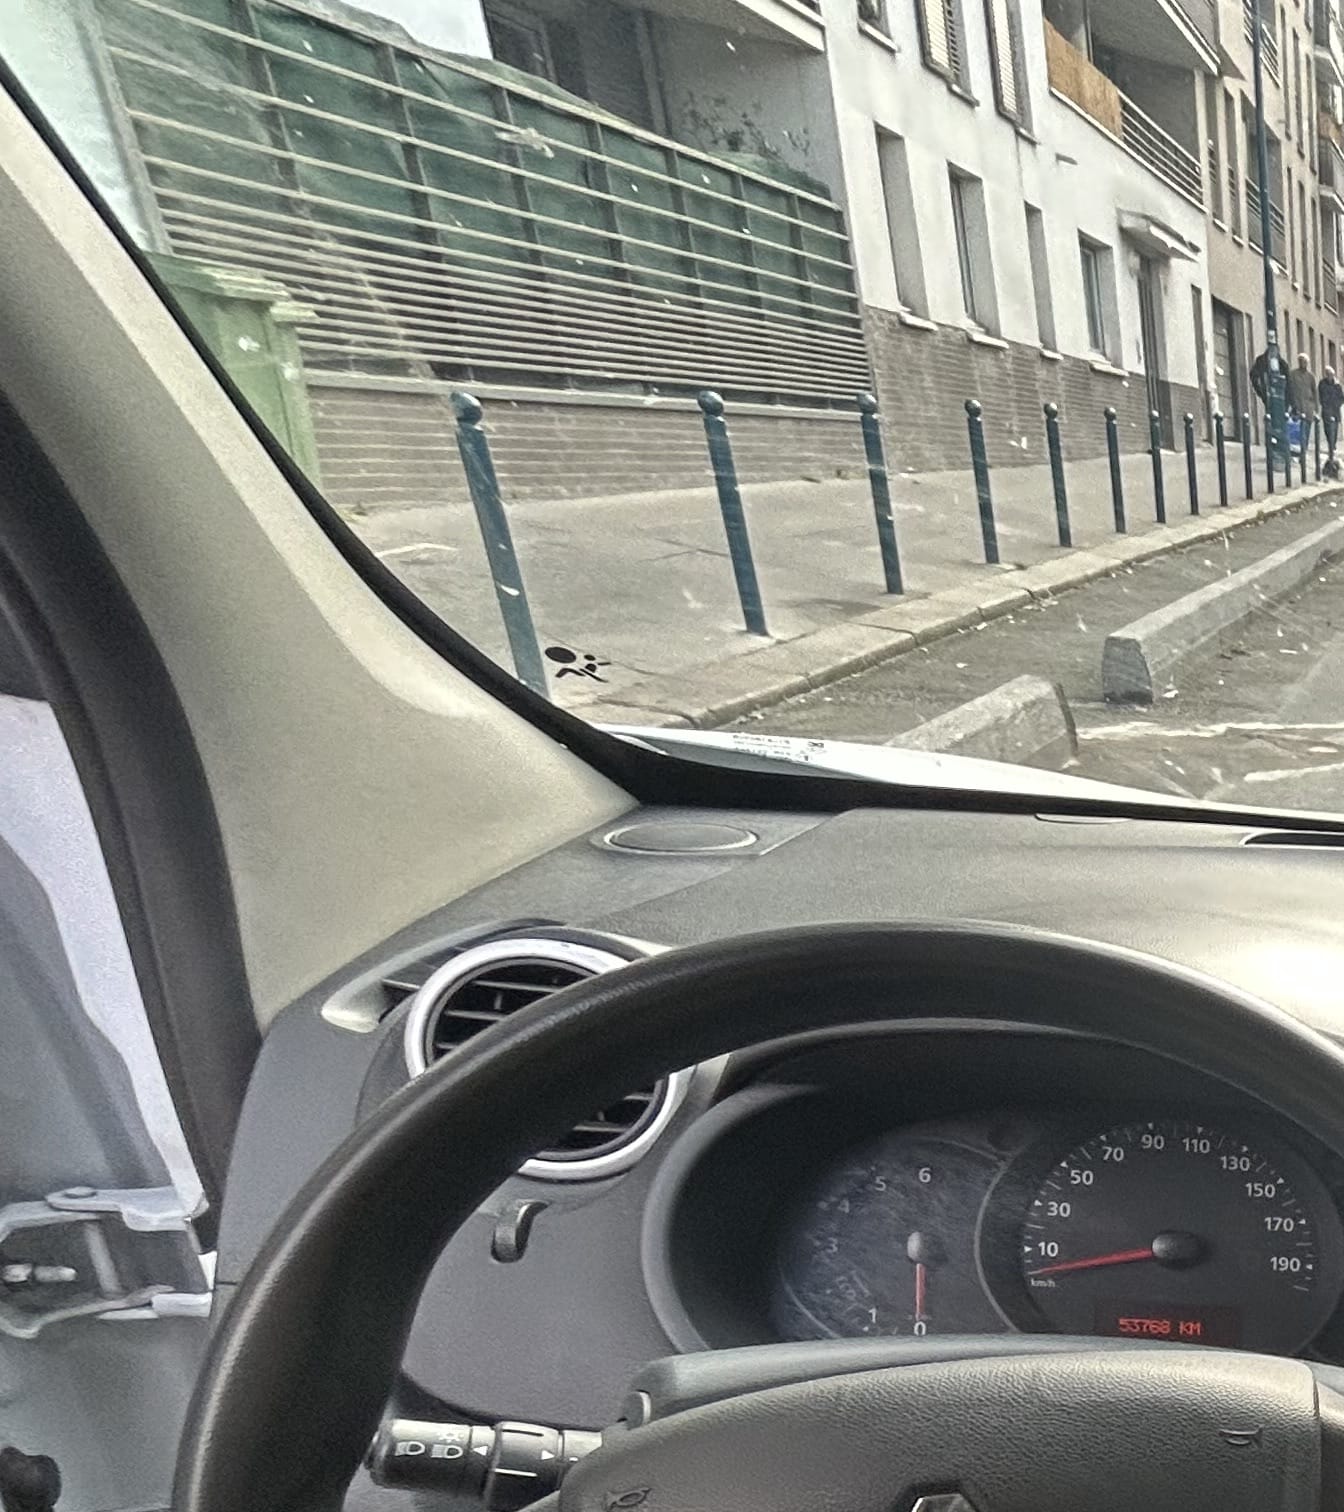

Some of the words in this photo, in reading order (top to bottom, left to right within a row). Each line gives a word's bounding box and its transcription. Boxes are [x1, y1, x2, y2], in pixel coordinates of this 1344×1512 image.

[1141, 1134, 1165, 1150] 90
[1182, 1137, 1211, 1154] 110
[1102, 1147, 1125, 1162] 70
[1220, 1156, 1251, 1171] 130
[918, 1167, 932, 1183] 6
[1070, 1169, 1094, 1186] 50
[874, 1176, 887, 1192] 5
[1245, 1183, 1276, 1198] 150
[1047, 1202, 1071, 1218] 30
[1264, 1217, 1294, 1232] 170
[1038, 1241, 1059, 1257] 10
[1270, 1256, 1301, 1272] 190
[1031, 1277, 1056, 1289] km/h
[868, 1307, 878, 1324] 1
[913, 1321, 927, 1337] 0
[1119, 1318, 1171, 1334] 53768
[1179, 1319, 1202, 1336] KM
